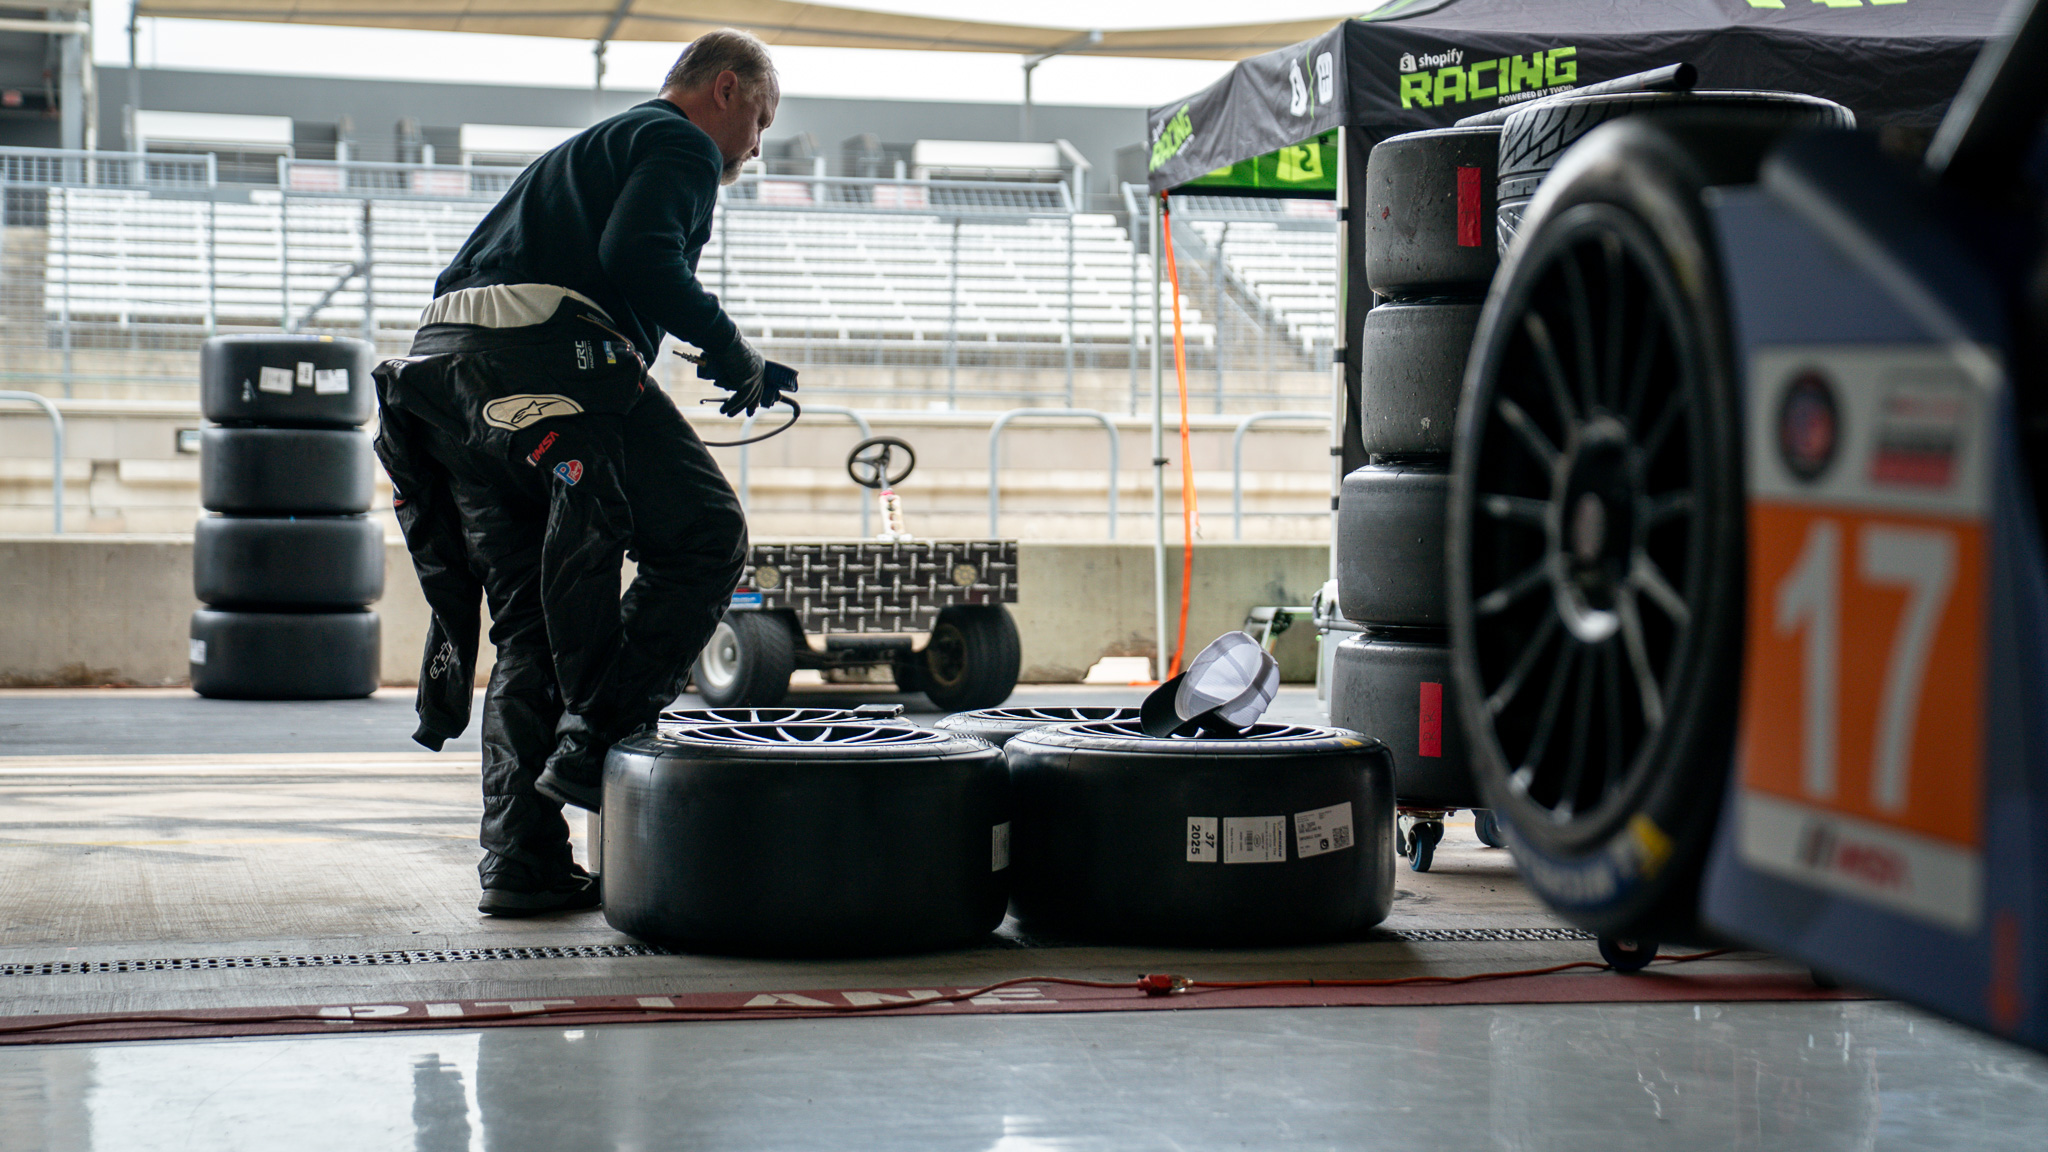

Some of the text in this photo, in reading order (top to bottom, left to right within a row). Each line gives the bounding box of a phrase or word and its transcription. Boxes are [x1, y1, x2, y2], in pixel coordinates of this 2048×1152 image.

[1418, 48, 1463, 68] shopify
[1401, 46, 1577, 109] RACING
[1498, 90, 1537, 105] POWERED
[1537, 88, 1548, 98] BY
[574, 340, 588, 370] CRC
[531, 431, 560, 462] IMSA
[1774, 517, 1958, 814] 17
[1191, 824, 1201, 855] 2025
[1205, 832, 1215, 849] 37
[319, 999, 575, 1023] PIT
